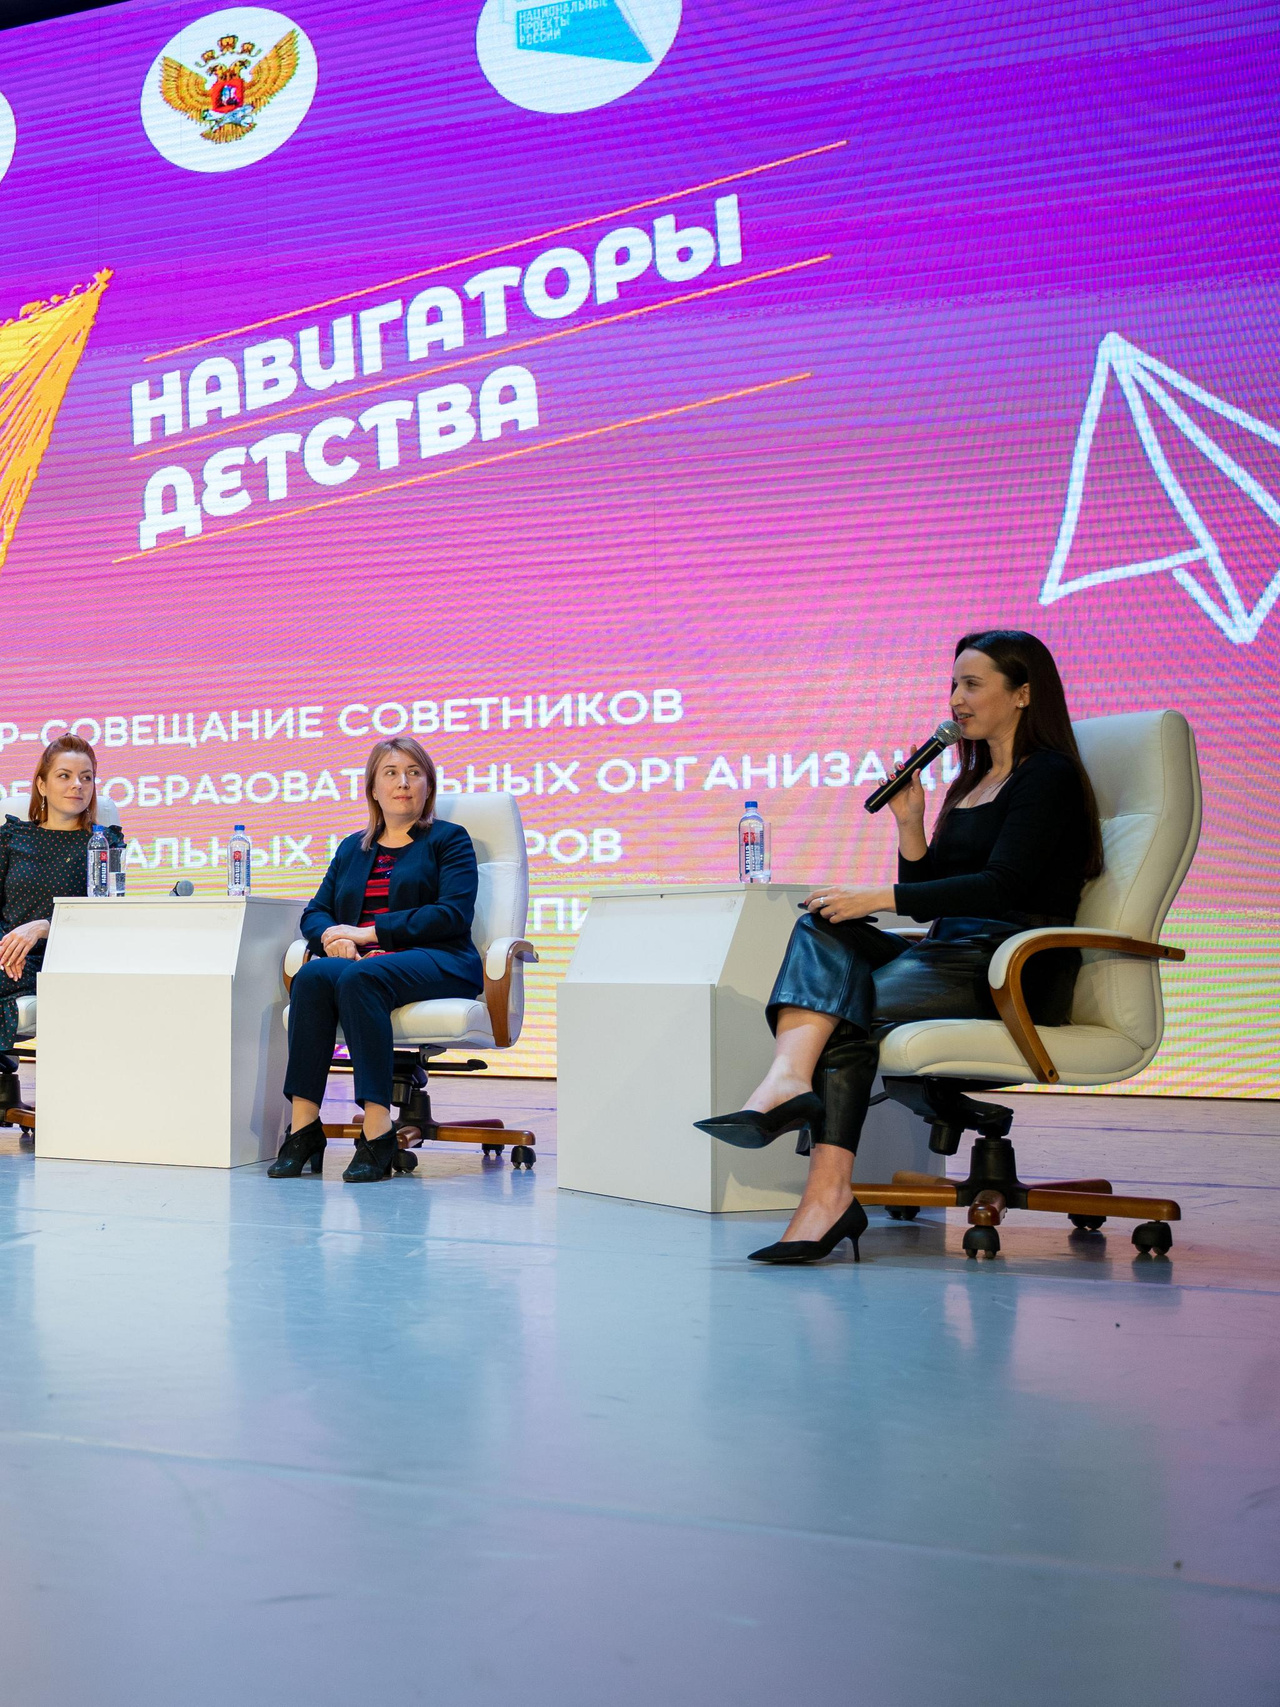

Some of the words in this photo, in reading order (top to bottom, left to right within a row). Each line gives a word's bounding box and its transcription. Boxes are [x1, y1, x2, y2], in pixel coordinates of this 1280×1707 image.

[519, 14, 570, 35] ПРОЕКТЫ
[519, 28, 562, 47] РОССИИ
[130, 193, 743, 446] НАВИГАТОРЫ
[138, 365, 539, 550] ДЕТСТВА
[338, 688, 685, 737] СОВЕТНИКОВ
